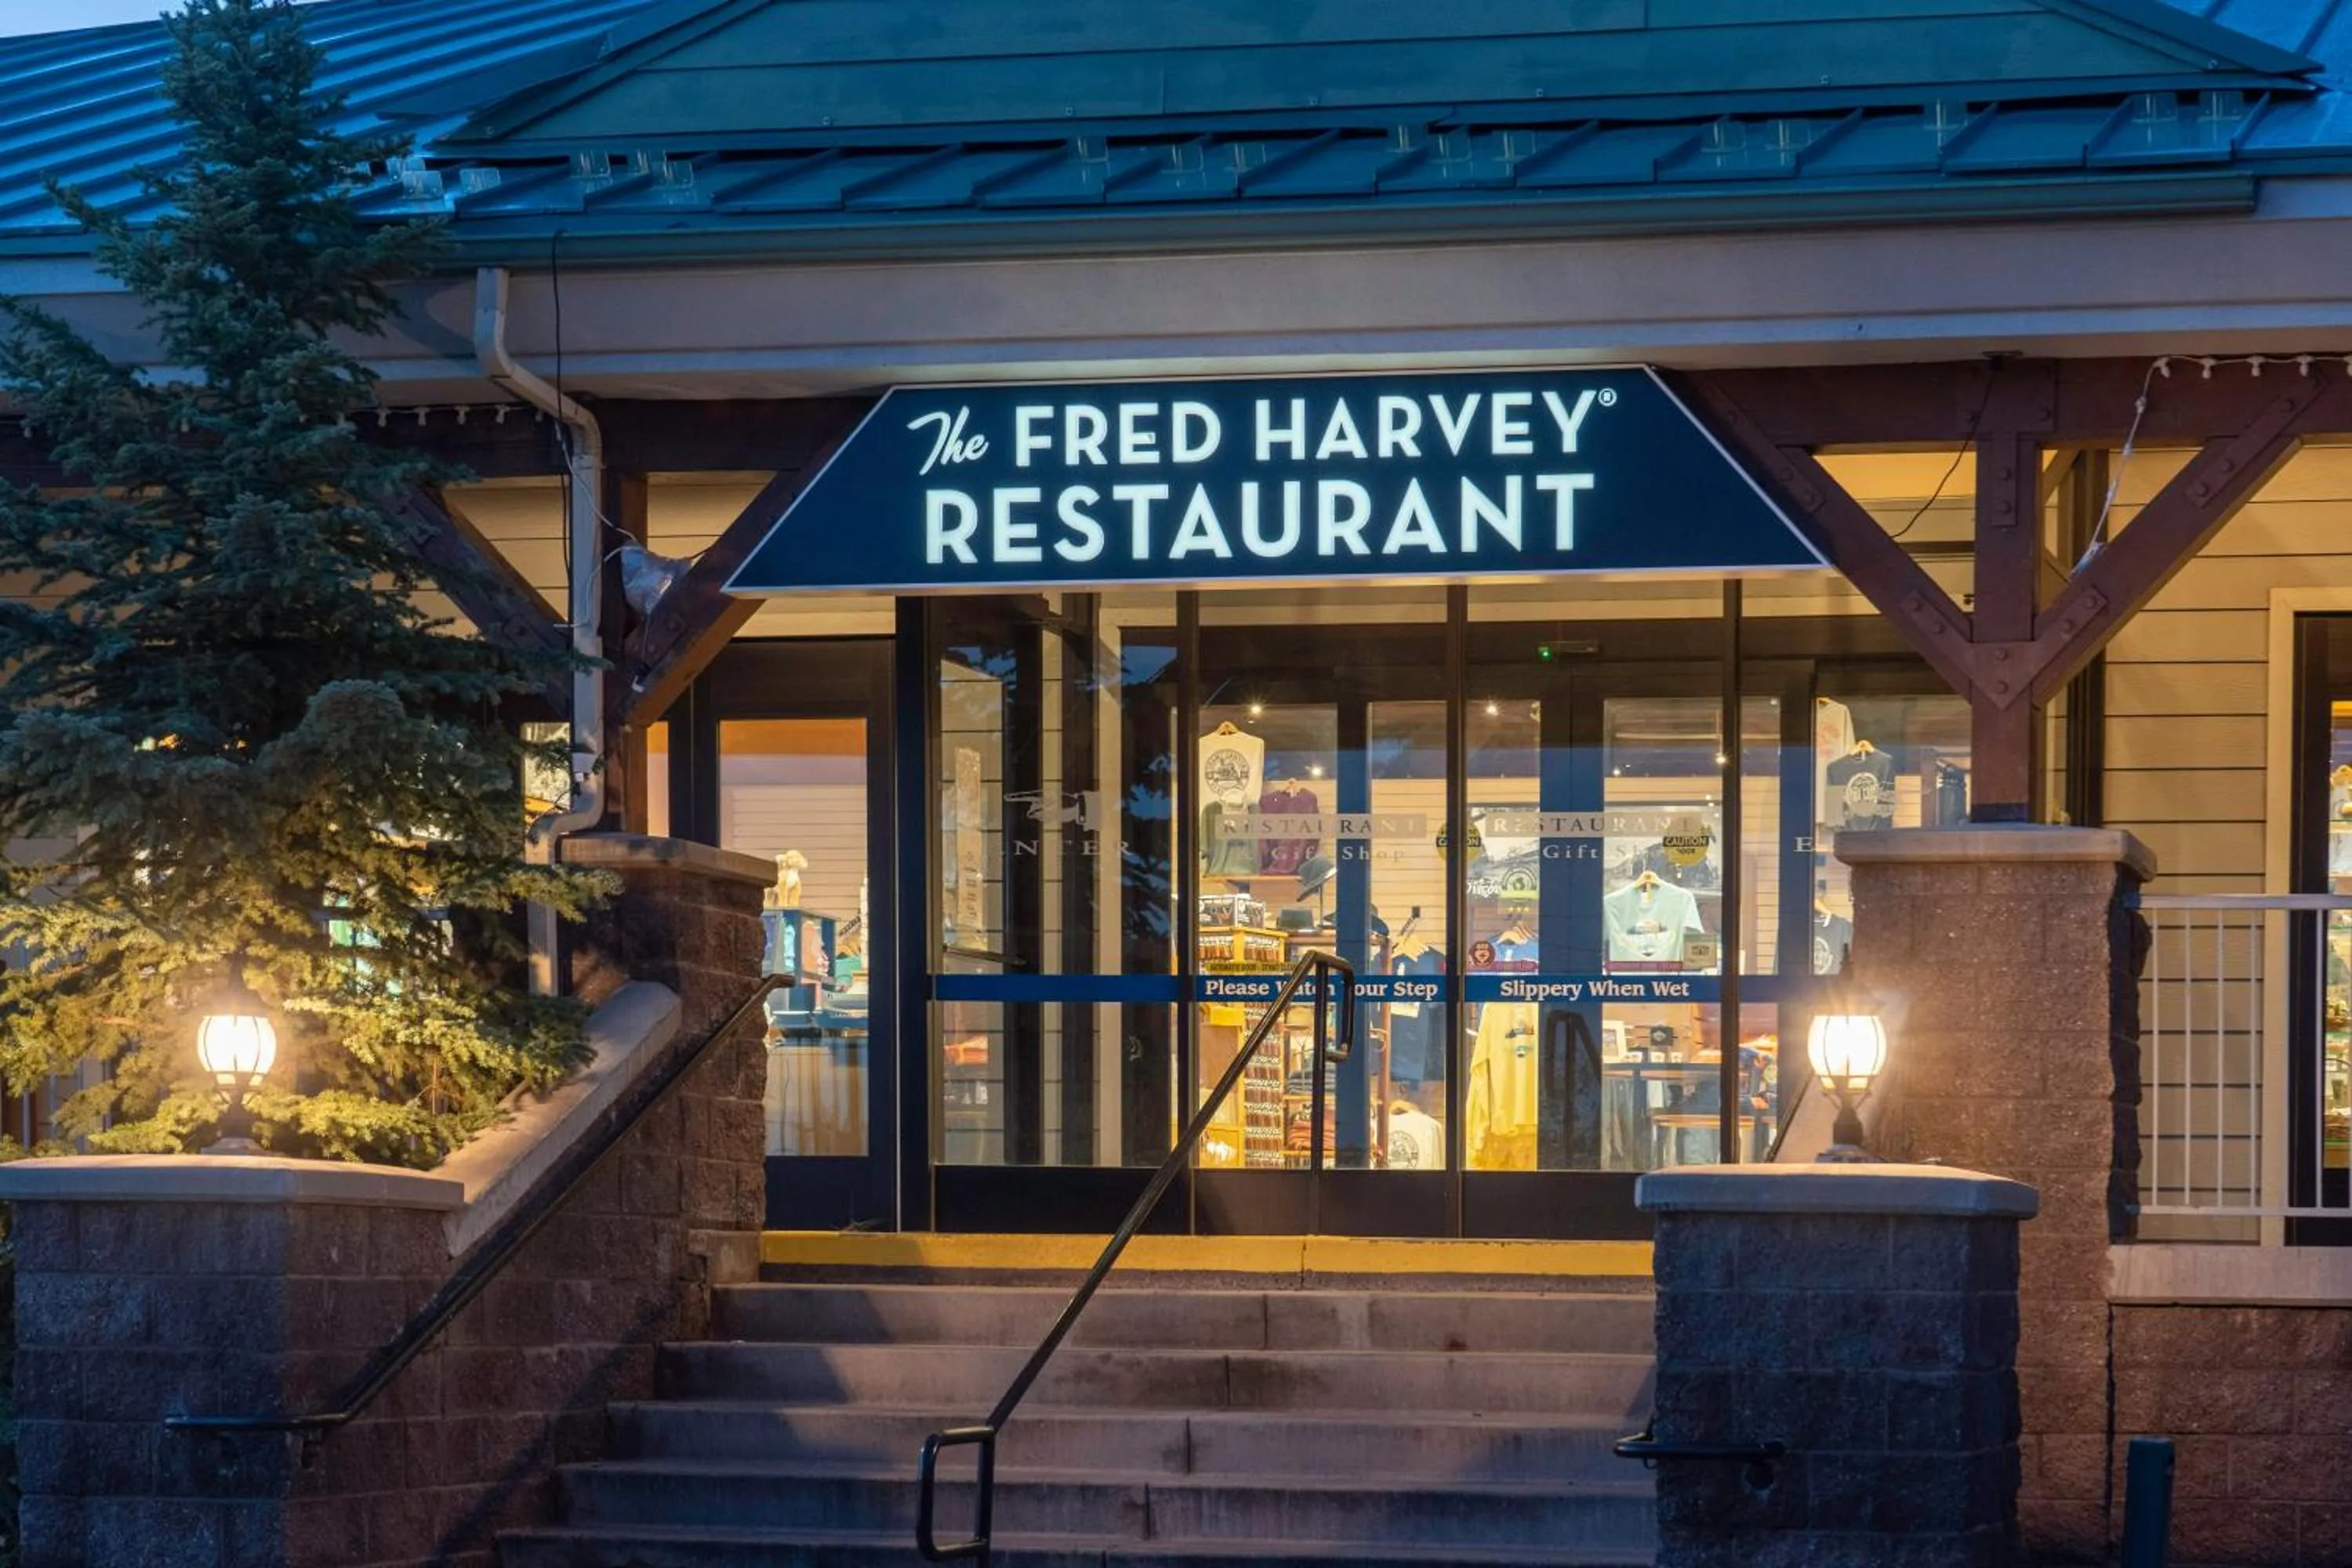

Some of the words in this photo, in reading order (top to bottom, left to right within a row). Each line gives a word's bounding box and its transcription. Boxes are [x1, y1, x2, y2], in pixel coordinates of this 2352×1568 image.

[906, 405, 989, 476] The
[1014, 401, 1221, 467] FRED
[925, 473, 1595, 564] RESTAURANT
[1223, 819, 1416, 834] RSTARANT
[1542, 844, 1600, 859] Gift
[1664, 836, 1707, 847] CAUTION
[1204, 979, 1270, 996] Please
[1341, 981, 1388, 996] our
[1392, 981, 1439, 1000] Step
[1500, 981, 1582, 1001] Slippery
[1588, 981, 1645, 996] When
[1651, 981, 1690, 996] Wet
